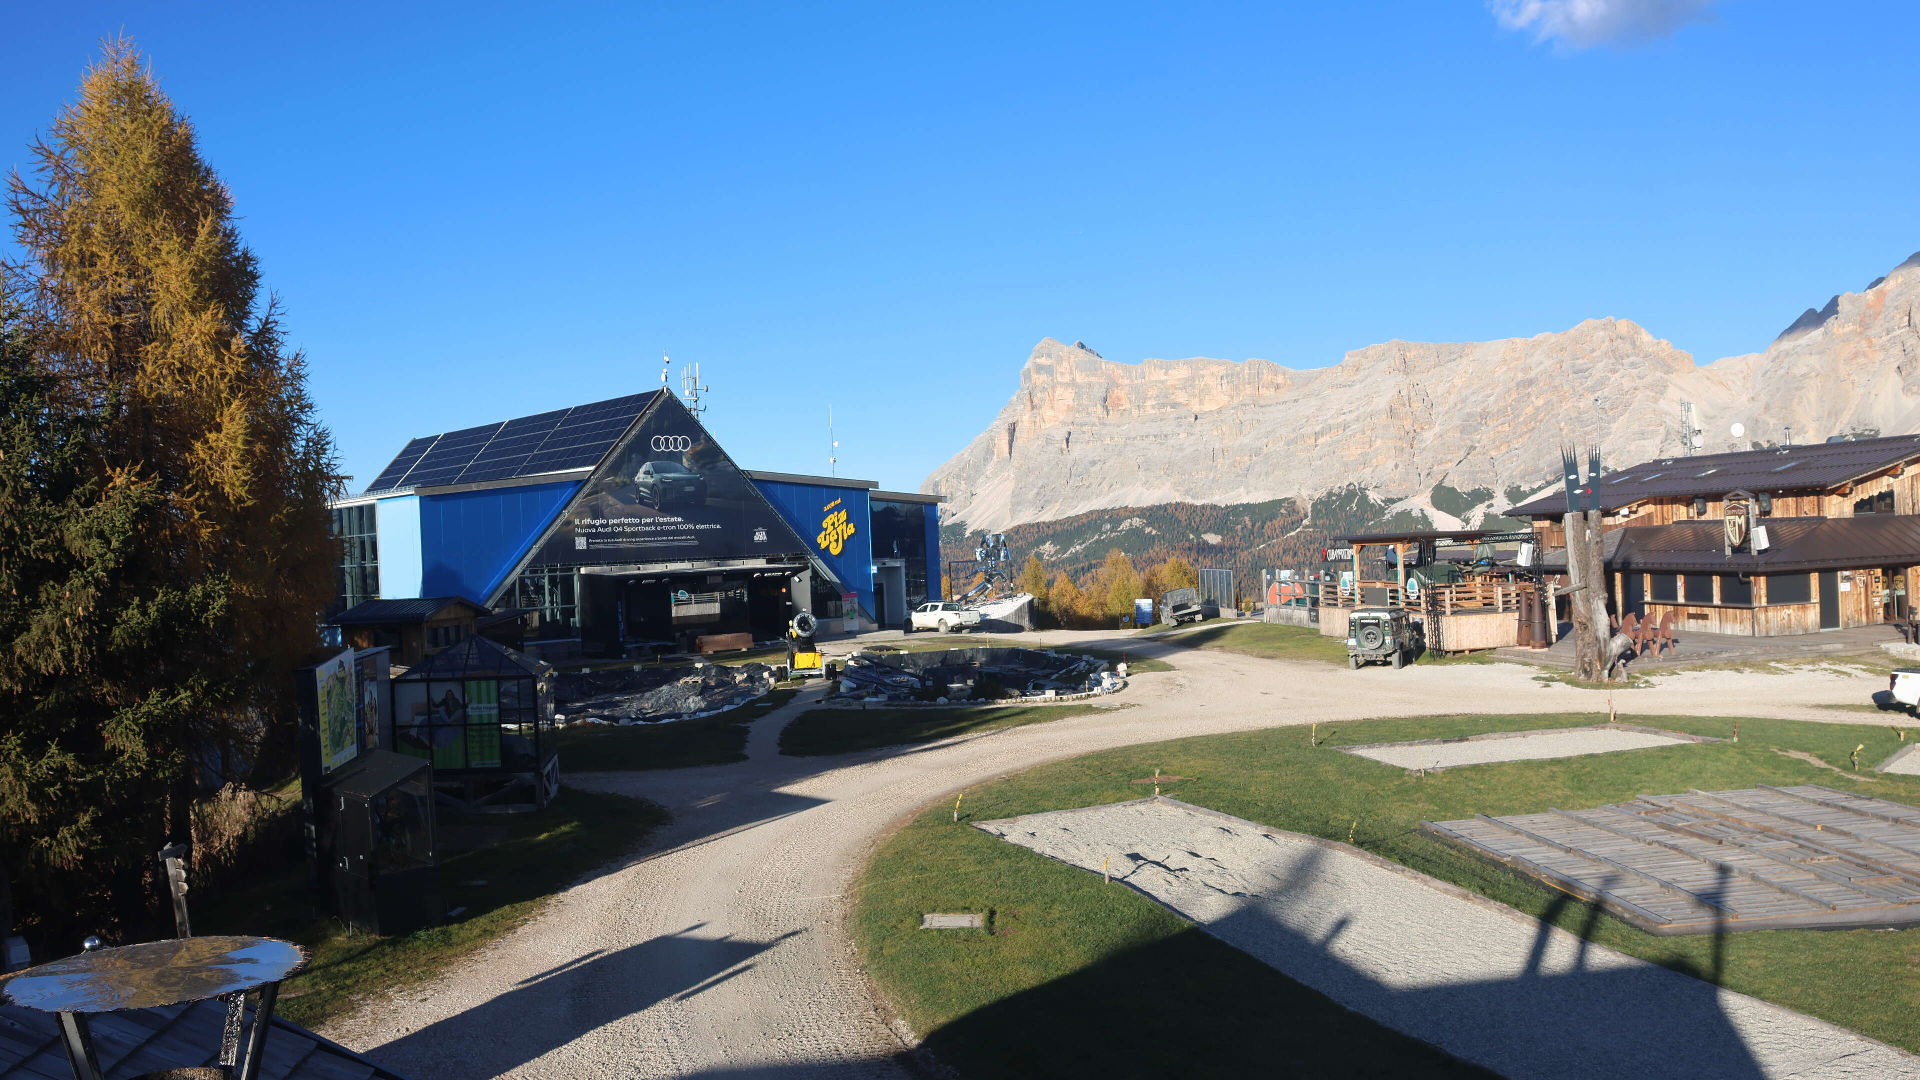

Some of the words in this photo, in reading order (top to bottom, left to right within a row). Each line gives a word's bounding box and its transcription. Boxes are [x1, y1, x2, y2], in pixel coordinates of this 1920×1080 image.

[582, 518, 607, 526] rifugio
[608, 517, 640, 525] perfetto
[641, 517, 654, 525] per
[822, 509, 847, 534] Piz
[623, 525, 656, 533] Sportback
